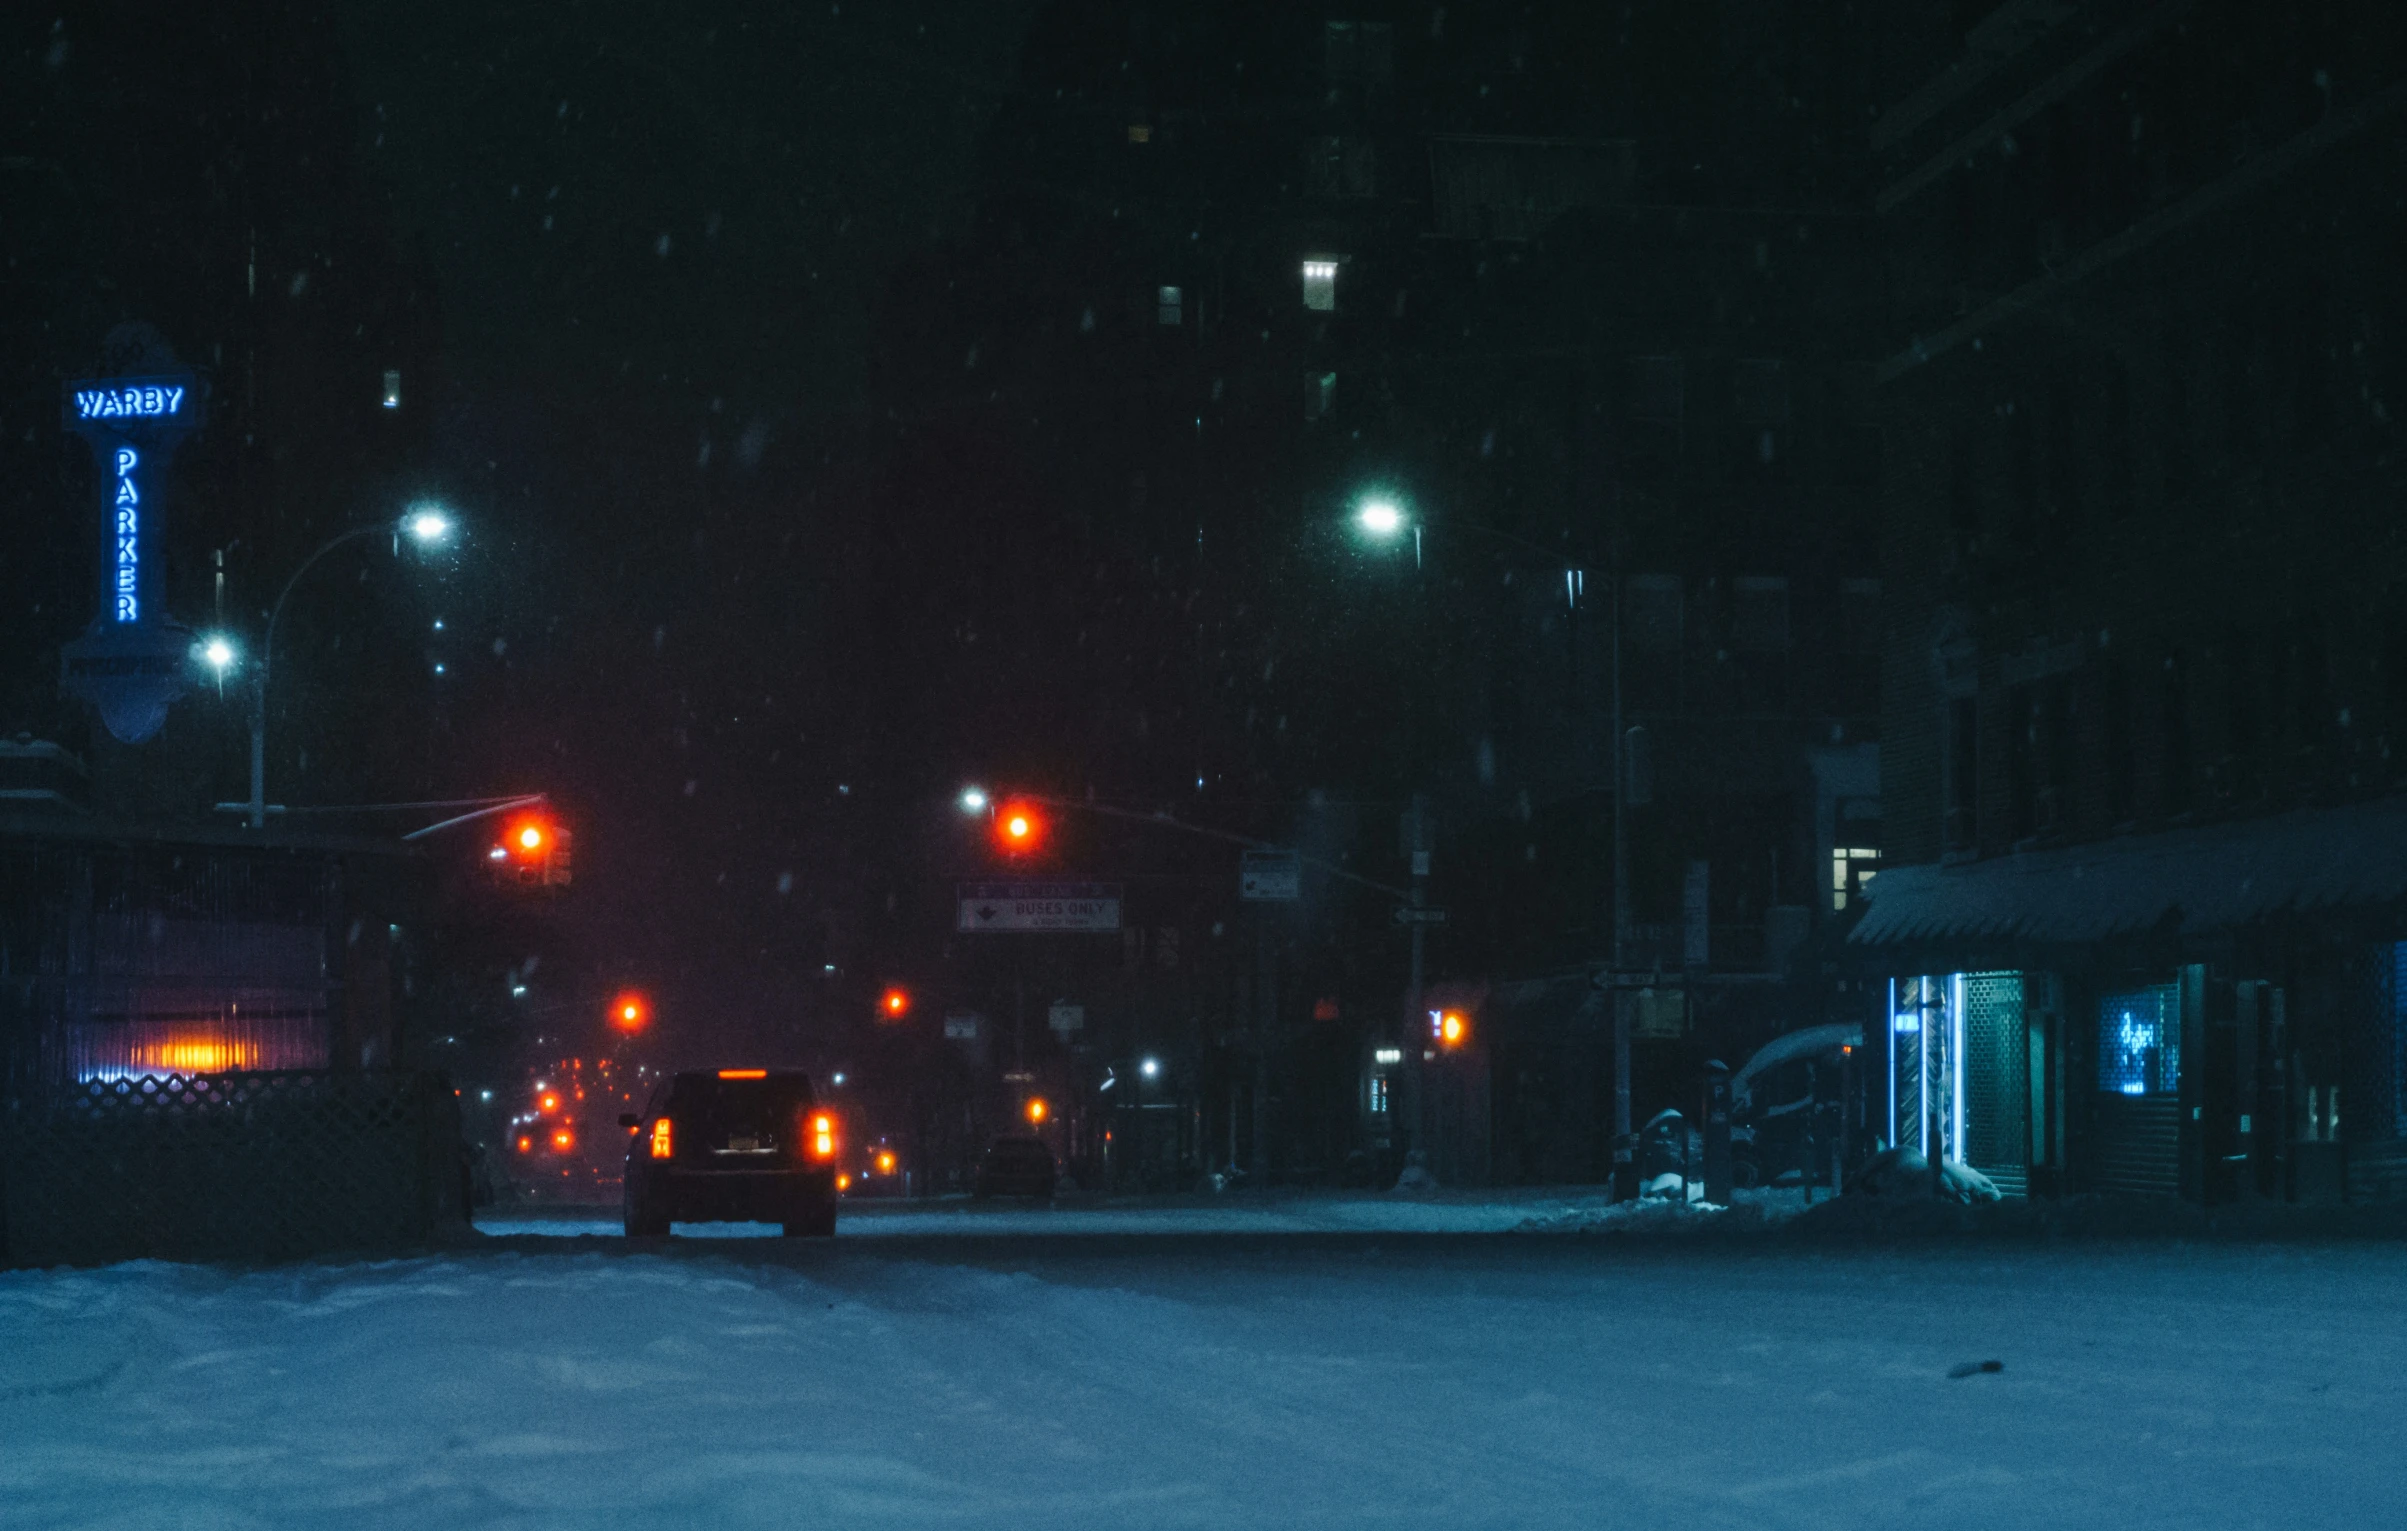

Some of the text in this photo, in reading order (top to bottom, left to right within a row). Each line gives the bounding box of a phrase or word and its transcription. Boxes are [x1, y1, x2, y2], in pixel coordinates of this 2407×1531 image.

[75, 386, 184, 418] WARBY
[115, 448, 139, 622] PARKER
[1015, 901, 1107, 916] BUSES ONLY
